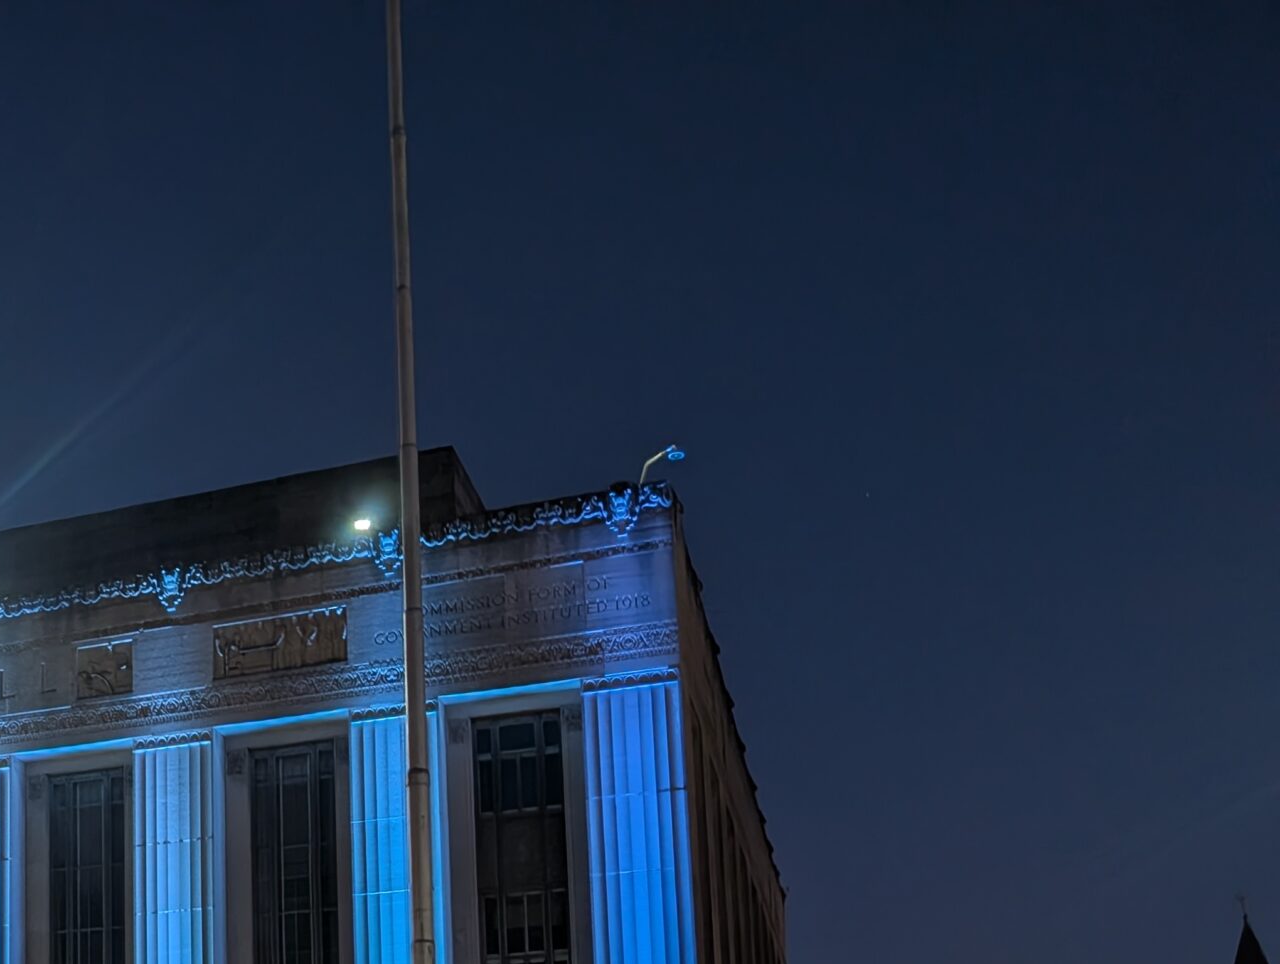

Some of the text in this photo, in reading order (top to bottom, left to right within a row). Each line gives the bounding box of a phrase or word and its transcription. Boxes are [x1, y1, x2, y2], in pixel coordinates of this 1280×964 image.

[374, 593, 651, 646] GOVNMENT INSTITUTED 1918
[422, 588, 519, 616] OMMISSION
[528, 581, 577, 602] FORM
